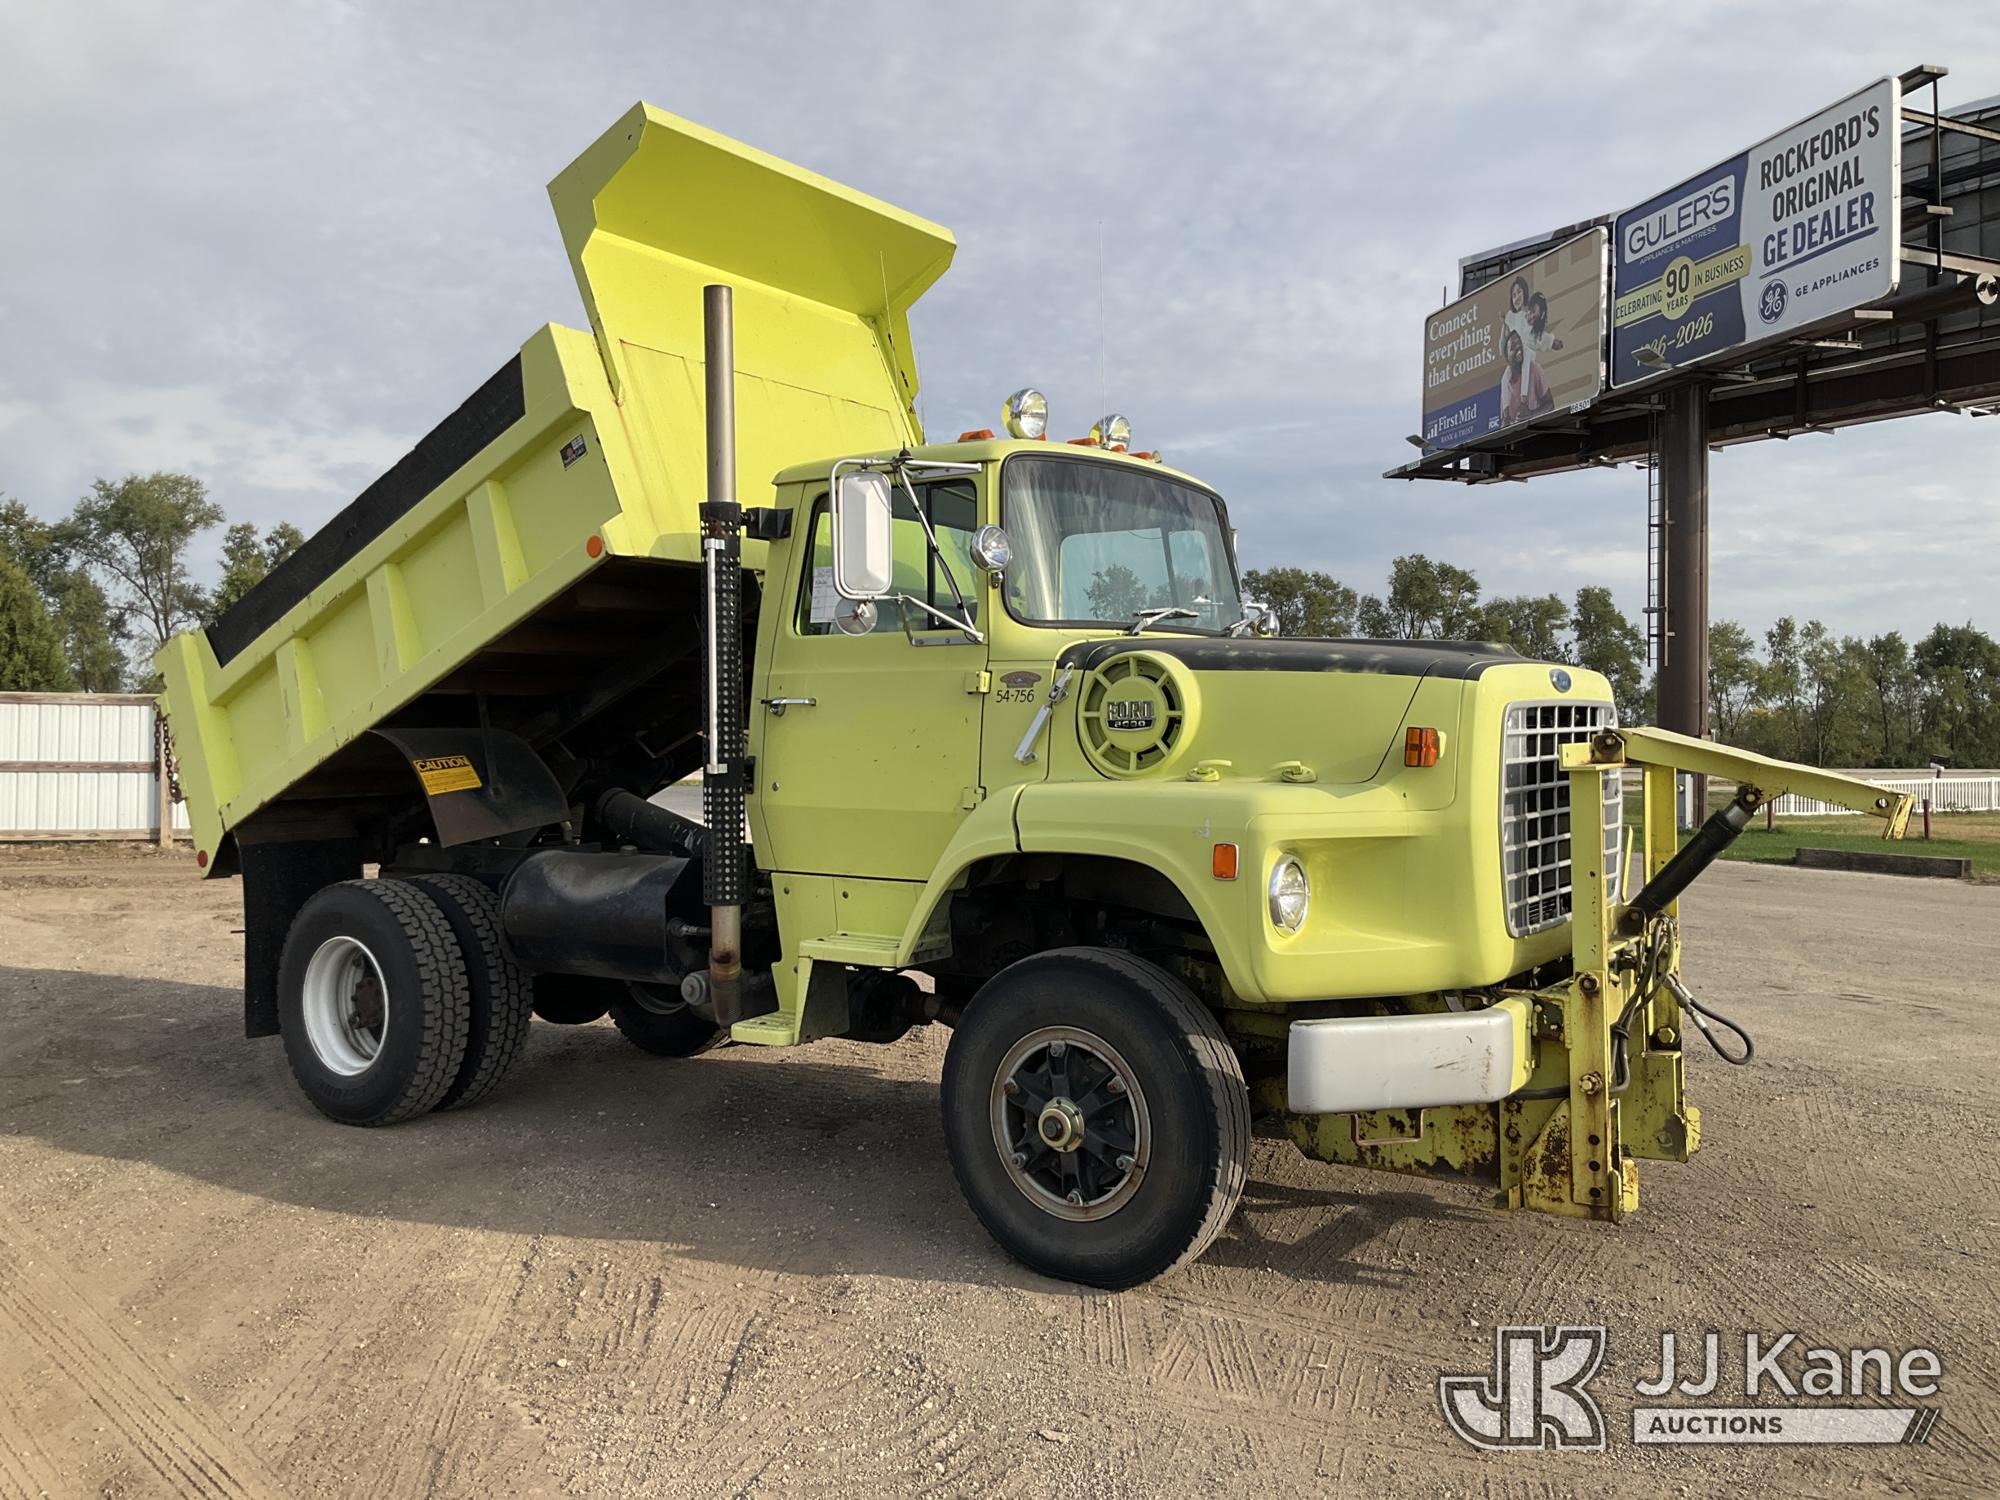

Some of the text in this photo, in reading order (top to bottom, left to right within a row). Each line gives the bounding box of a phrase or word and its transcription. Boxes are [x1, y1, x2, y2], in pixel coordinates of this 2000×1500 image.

[1760, 105, 1880, 191] ROCKFORD'S
[1772, 155, 1865, 222] ORIGINAL
[1629, 184, 1730, 254] GULER'S
[1763, 191, 1875, 267] GE DEALER
[1640, 245, 1675, 265] APPLIANCE
[1681, 225, 1717, 245] MATTRESS
[1615, 255, 1744, 319] CELEBRATING IN BUSINESS
[1666, 263, 1690, 298] 90
[1795, 258, 1880, 297] GE APPLIANCES
[1429, 304, 1477, 341] Connect
[1666, 295, 1689, 311] YEARS
[1428, 324, 1492, 364] everything
[1428, 348, 1496, 388] that counts.
[1438, 403, 1477, 431] First Mid
[996, 689, 1035, 703] 54-756
[1108, 700, 1154, 720] FORD
[418, 757, 471, 772] CAUTION
